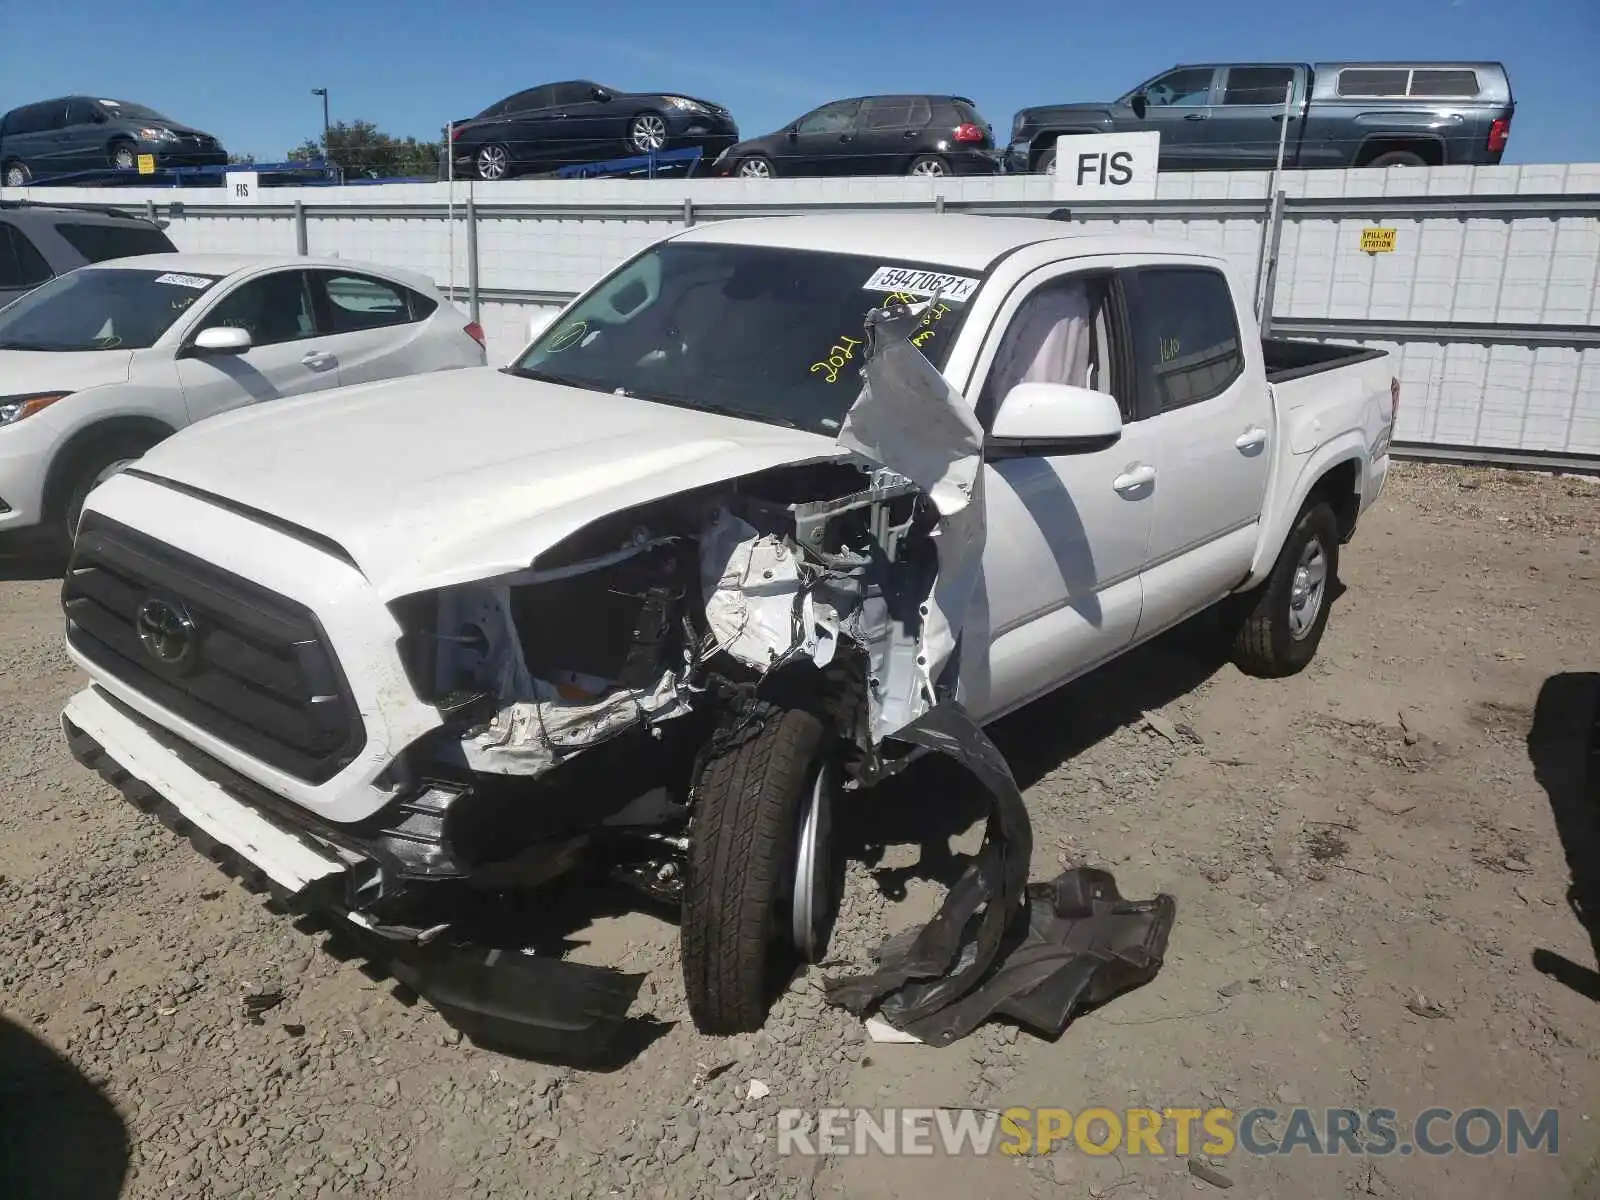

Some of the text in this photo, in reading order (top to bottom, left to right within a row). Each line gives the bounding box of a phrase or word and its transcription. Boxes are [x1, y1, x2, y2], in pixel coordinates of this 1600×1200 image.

[1077, 151, 1133, 186] FIS
[236, 183, 249, 197] FIS
[1362, 231, 1395, 240] SPILL-KIT
[1363, 240, 1392, 248] STATION
